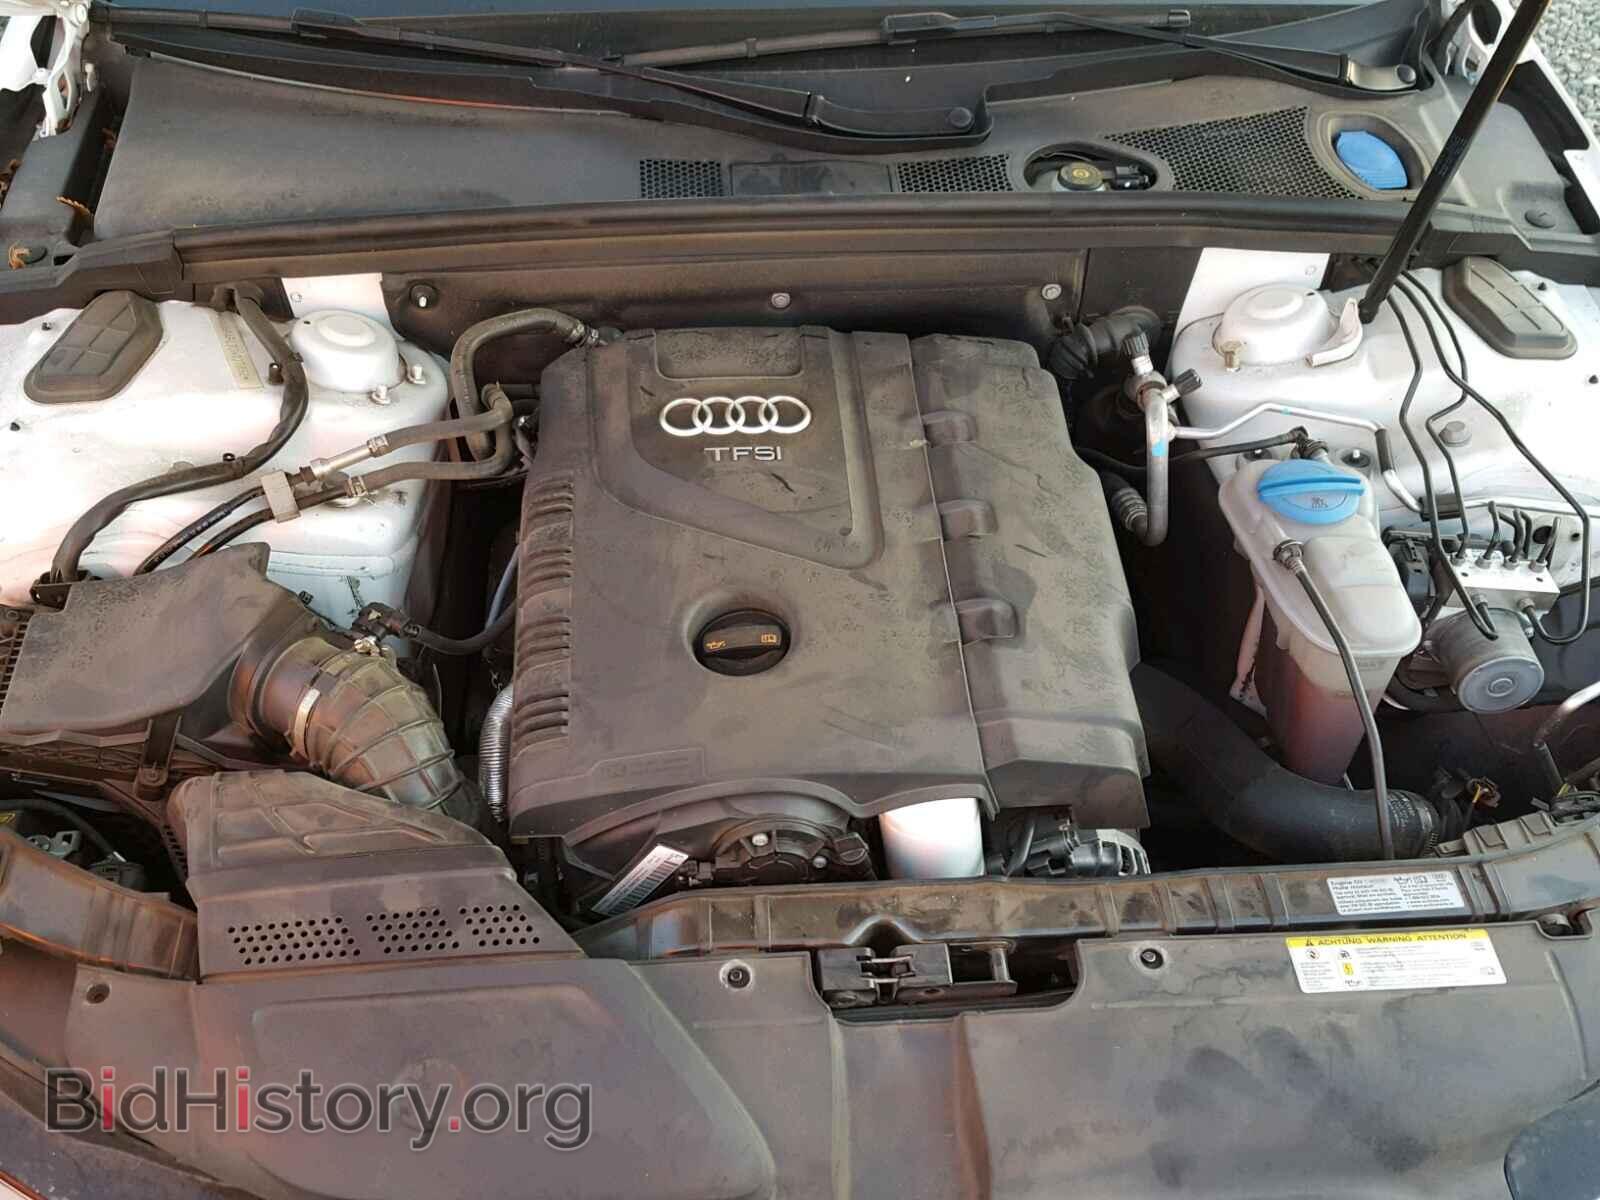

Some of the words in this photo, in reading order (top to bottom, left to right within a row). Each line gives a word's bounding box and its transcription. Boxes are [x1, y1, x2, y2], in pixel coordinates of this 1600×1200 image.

[704, 446, 782, 462] TFSI
[1318, 937, 1362, 945] ACHTUNG
[1366, 935, 1412, 943] WARNING
[1416, 933, 1467, 941] ATTENTION
